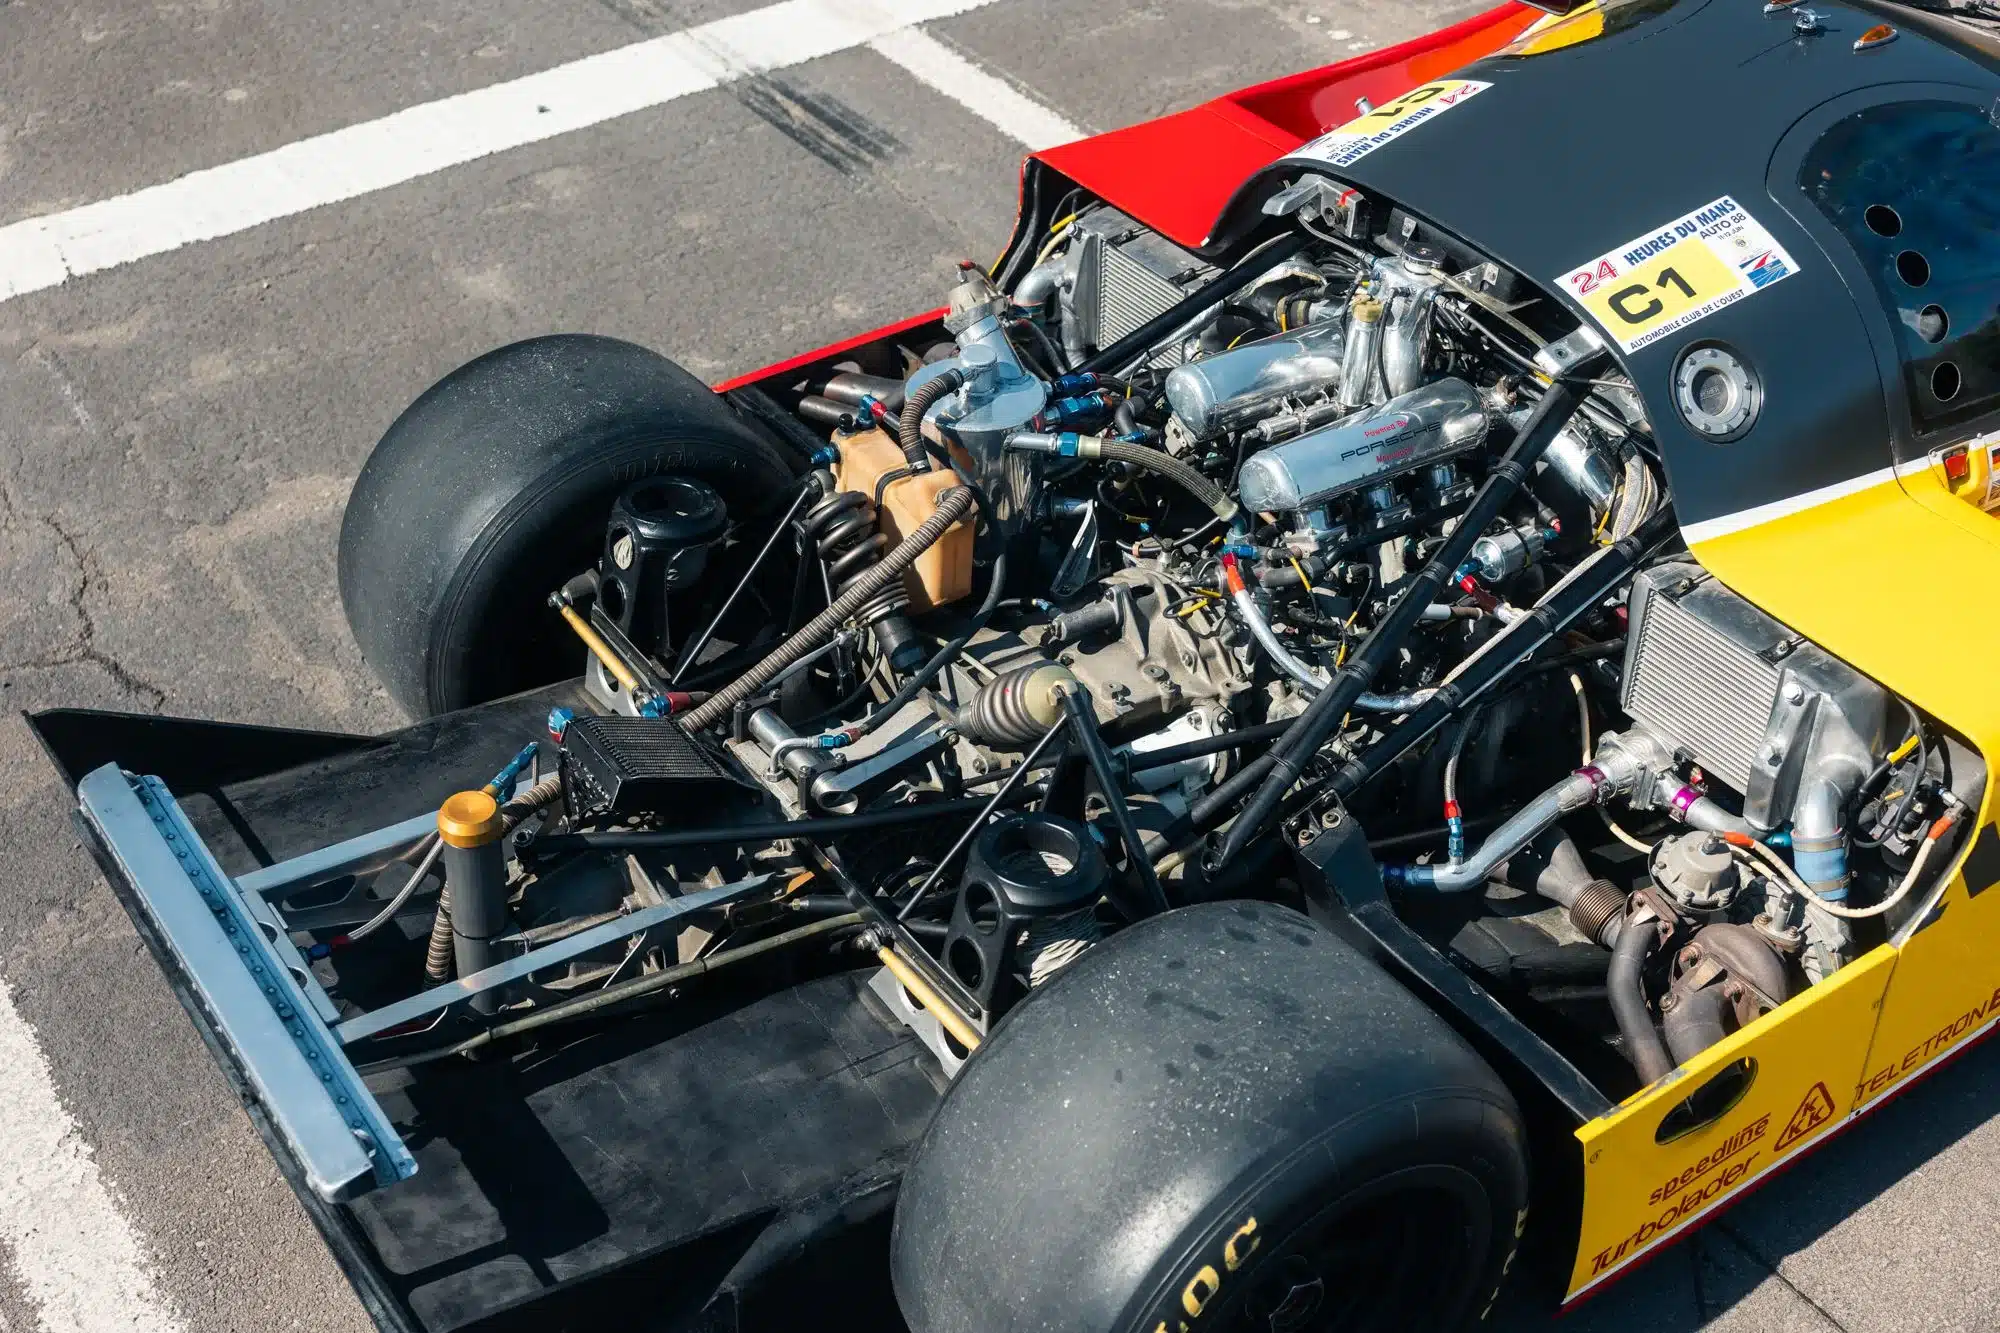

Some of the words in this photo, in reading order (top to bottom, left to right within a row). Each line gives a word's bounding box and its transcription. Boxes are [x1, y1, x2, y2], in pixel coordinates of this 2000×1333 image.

[1369, 86, 1445, 117] C1
[1389, 107, 1435, 133] HEURES
[1336, 142, 1373, 165] MANS
[1371, 131, 1392, 144] DU
[1699, 220, 1731, 240] AUTO
[1730, 212, 1747, 224] 88
[1570, 259, 1619, 297] 24
[1623, 232, 1677, 266] HEURES
[1674, 220, 1698, 239] DU
[1695, 199, 1736, 228] MANS
[1608, 267, 1697, 325] C1
[1630, 320, 1681, 350] AUTOMOBILE
[1681, 310, 1702, 325] CLUB
[1701, 304, 1713, 315] DE
[1713, 289, 1745, 309] L'OUEST
[1340, 421, 1441, 461] PORSCHE
[1648, 1114, 1770, 1206] speedline
[1591, 1151, 1761, 1276] Turbolader
